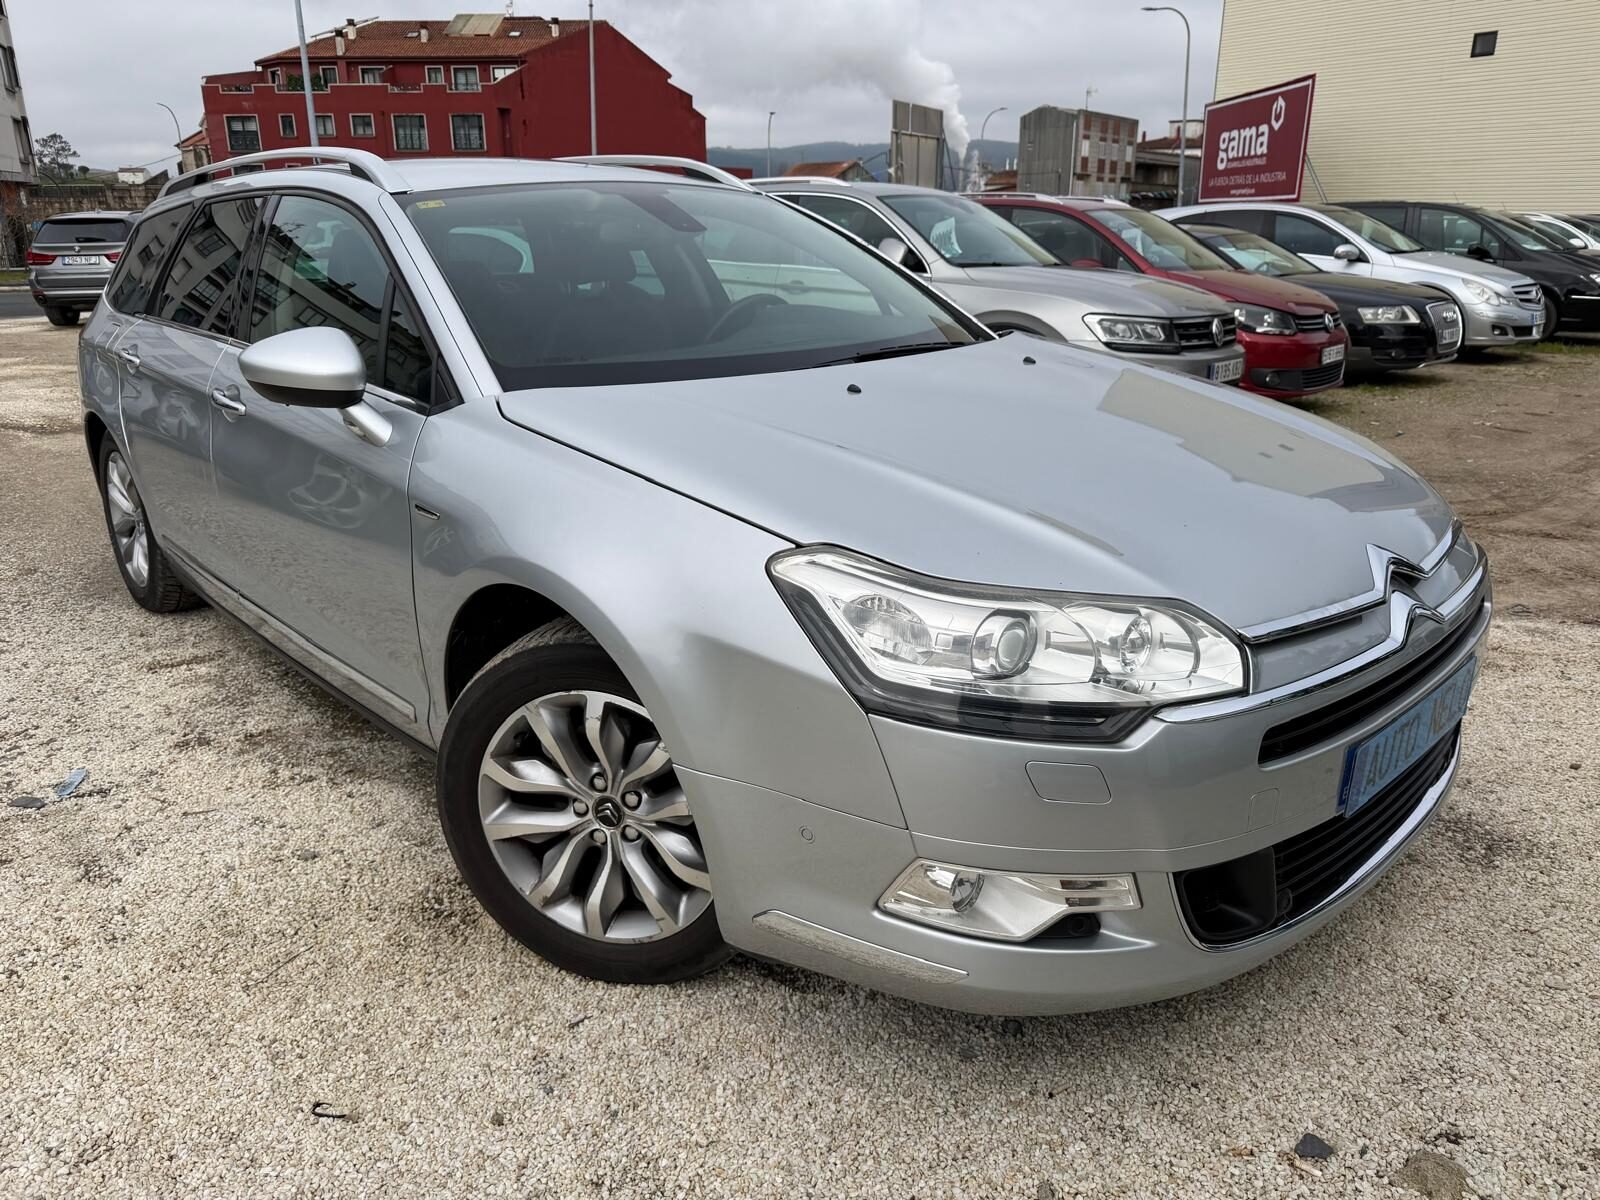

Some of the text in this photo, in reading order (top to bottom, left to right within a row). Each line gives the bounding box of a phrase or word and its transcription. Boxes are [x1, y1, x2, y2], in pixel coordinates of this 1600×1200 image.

[1216, 123, 1269, 170] gama
[1253, 173, 1259, 183] LA
[1259, 171, 1286, 182] INDUSTRIA
[1363, 714, 1422, 796] AUTO
